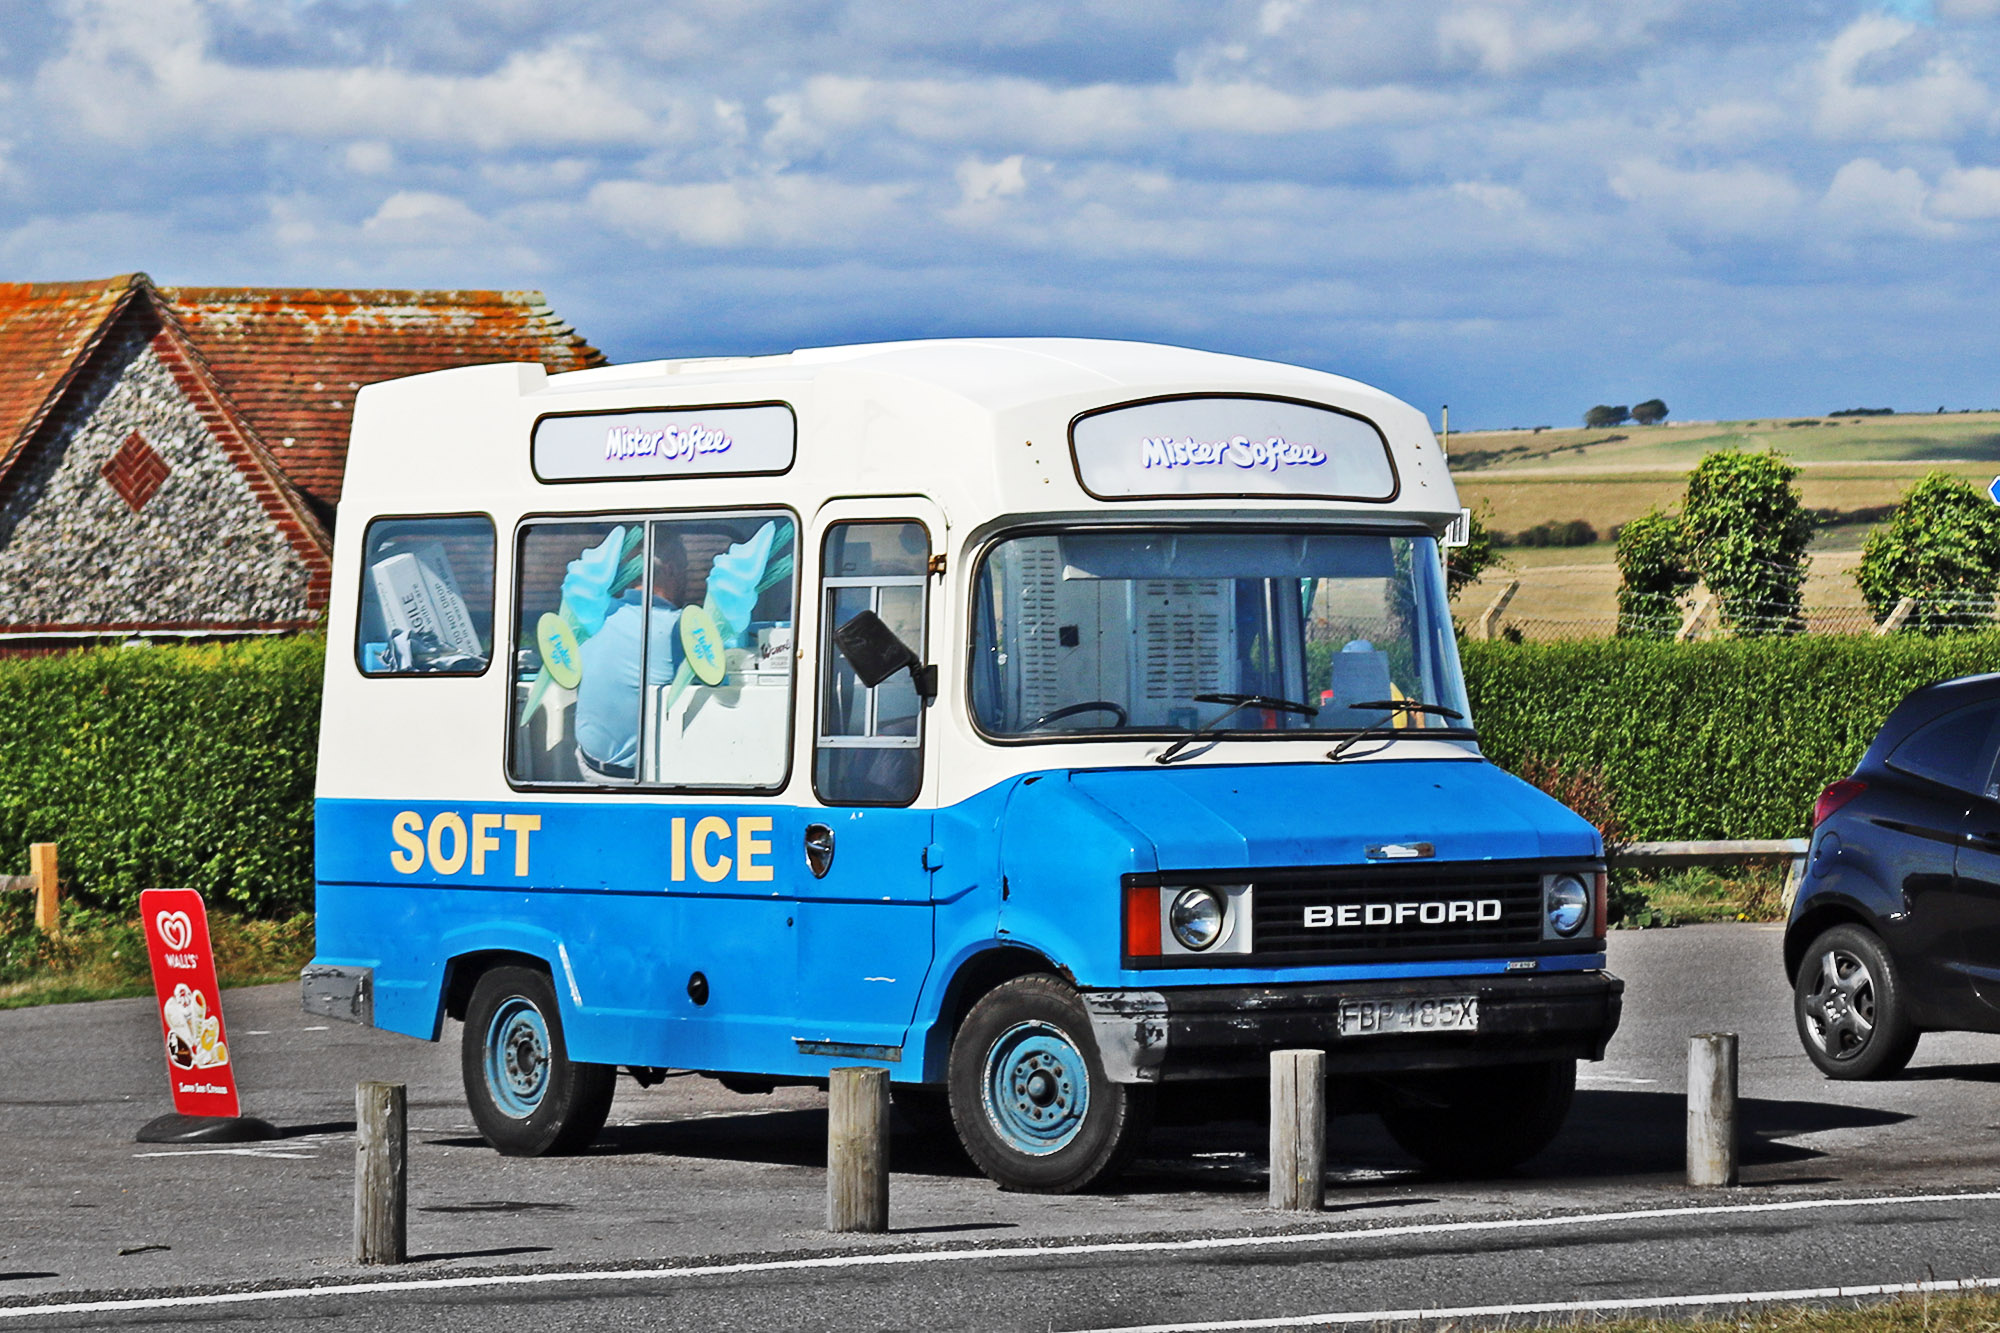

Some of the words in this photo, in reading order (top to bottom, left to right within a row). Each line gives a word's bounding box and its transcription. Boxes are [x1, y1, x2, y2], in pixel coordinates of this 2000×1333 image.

[606, 426, 664, 460] Mister
[660, 422, 732, 462] Softee
[1141, 437, 1230, 469] Mister
[1228, 434, 1328, 472] Softee
[435, 582, 449, 609] DROP
[445, 610, 457, 630] NOT
[390, 810, 542, 877] SOFT
[670, 816, 775, 883] ICE
[1303, 899, 1502, 928] BEDFORD
[1340, 1000, 1396, 1034] FBP
[1399, 997, 1478, 1028] 485X
